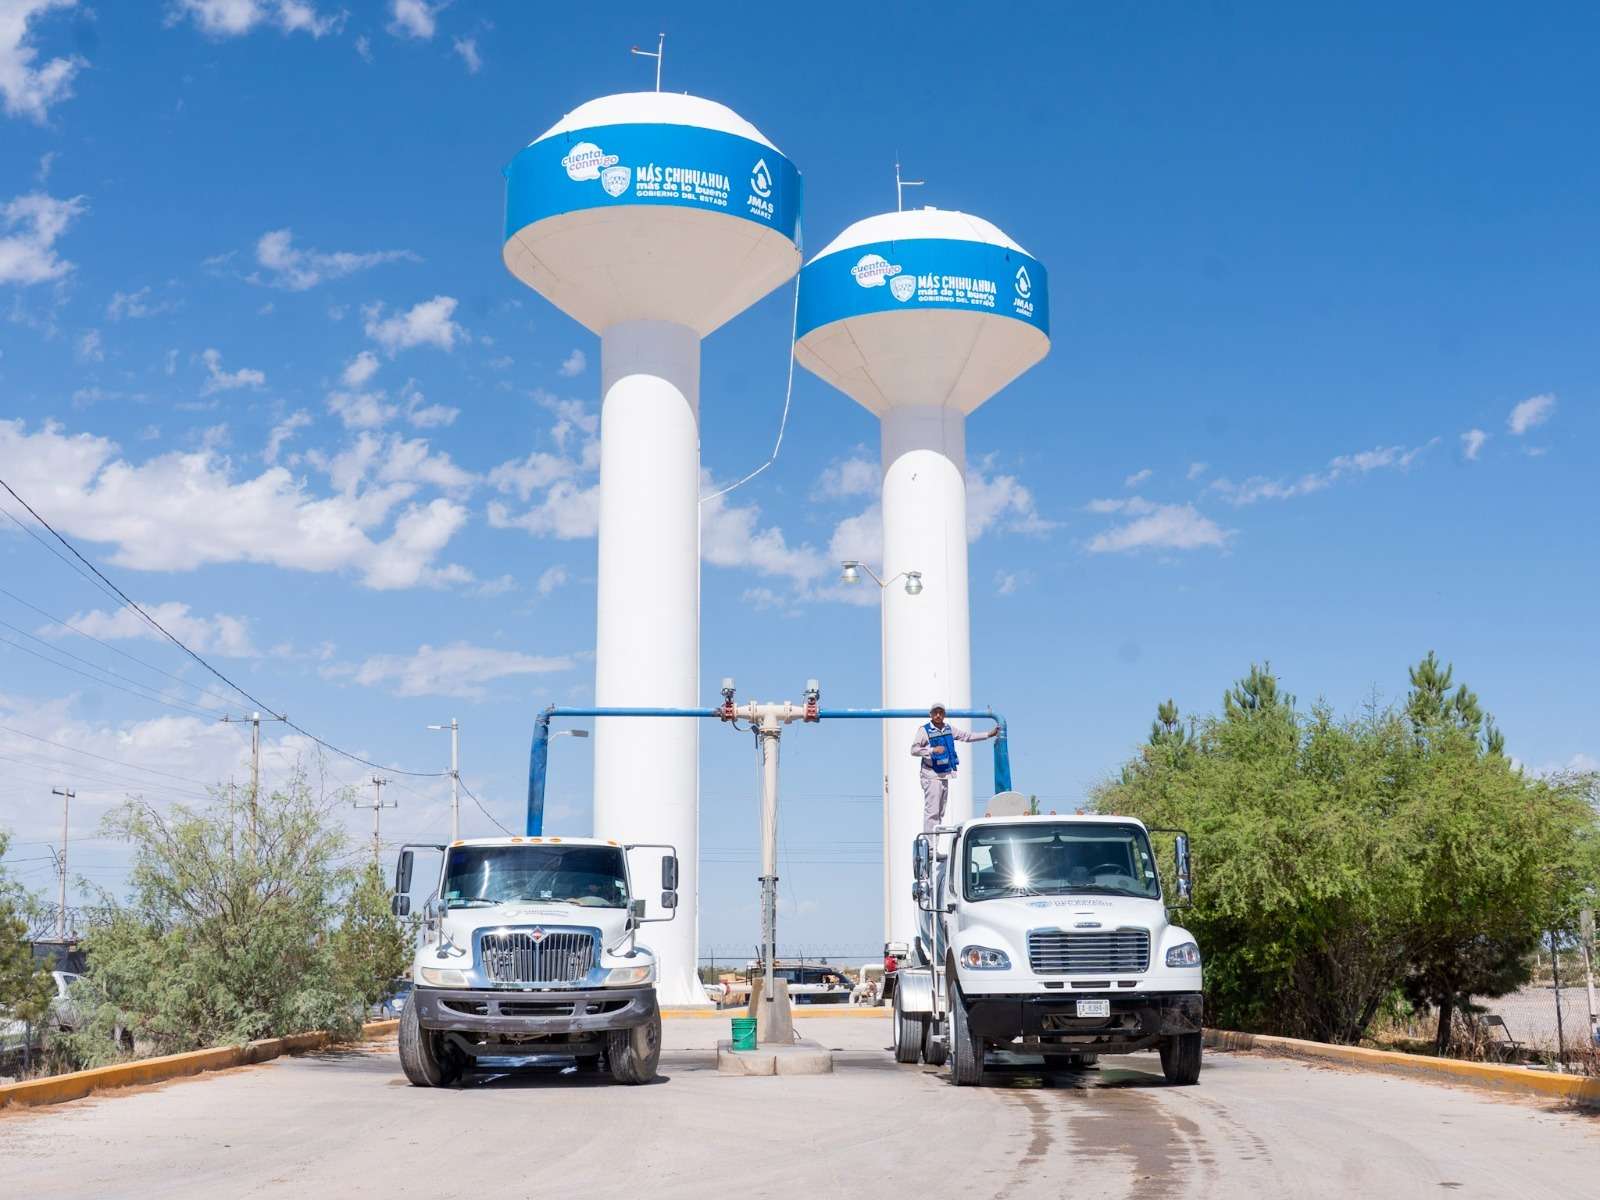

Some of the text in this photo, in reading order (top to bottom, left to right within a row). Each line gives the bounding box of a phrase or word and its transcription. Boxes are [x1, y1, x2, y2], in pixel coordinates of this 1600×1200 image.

[562, 149, 601, 166] cuenta
[569, 155, 617, 171] conmigo
[637, 162, 662, 183] MÁS
[665, 167, 730, 192] CHIHUAHUA
[636, 180, 660, 191] más
[663, 180, 677, 191] de
[681, 181, 692, 192] lo
[695, 183, 728, 199] bueno
[636, 190, 728, 207] GOBIERNO DEL ESTADO
[747, 194, 774, 213] JMAS
[852, 260, 886, 273] cuenta
[858, 266, 900, 279] conmigo
[918, 272, 940, 289] MÁS
[942, 275, 997, 295] CHIHUAHUA
[941, 286, 953, 296] de
[956, 288, 965, 297] lo
[1013, 297, 1034, 312] JMAS
